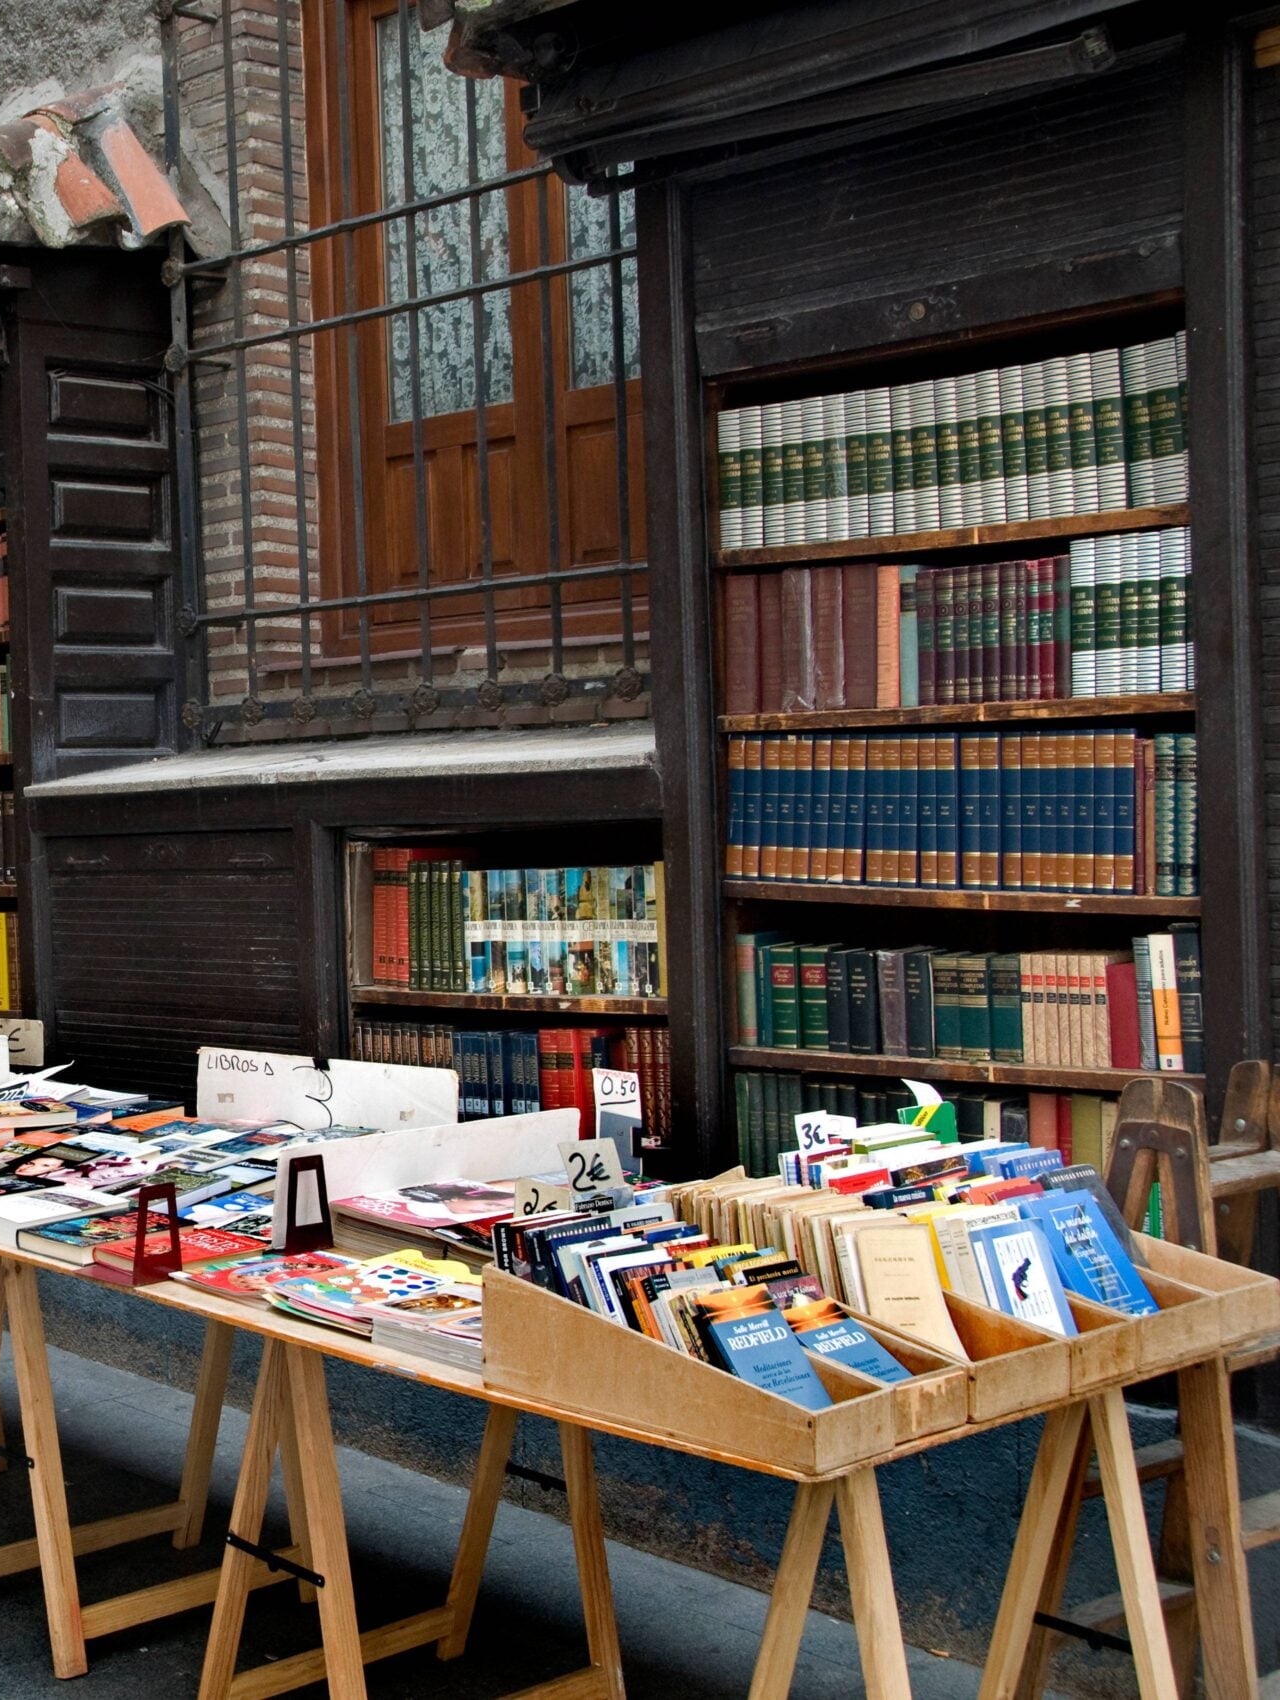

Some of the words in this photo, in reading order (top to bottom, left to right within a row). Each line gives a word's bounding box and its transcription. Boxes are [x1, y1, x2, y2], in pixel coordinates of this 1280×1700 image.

[207, 1054, 259, 1073] LIBROS
[601, 1076, 637, 1097] 0.50
[568, 1152, 611, 1192] 2€
[748, 1319, 770, 1332] Merrill
[727, 1326, 788, 1351] REDFIELD
[813, 1331, 867, 1354] REDFIELD
[752, 1359, 792, 1375] Meditaciones
